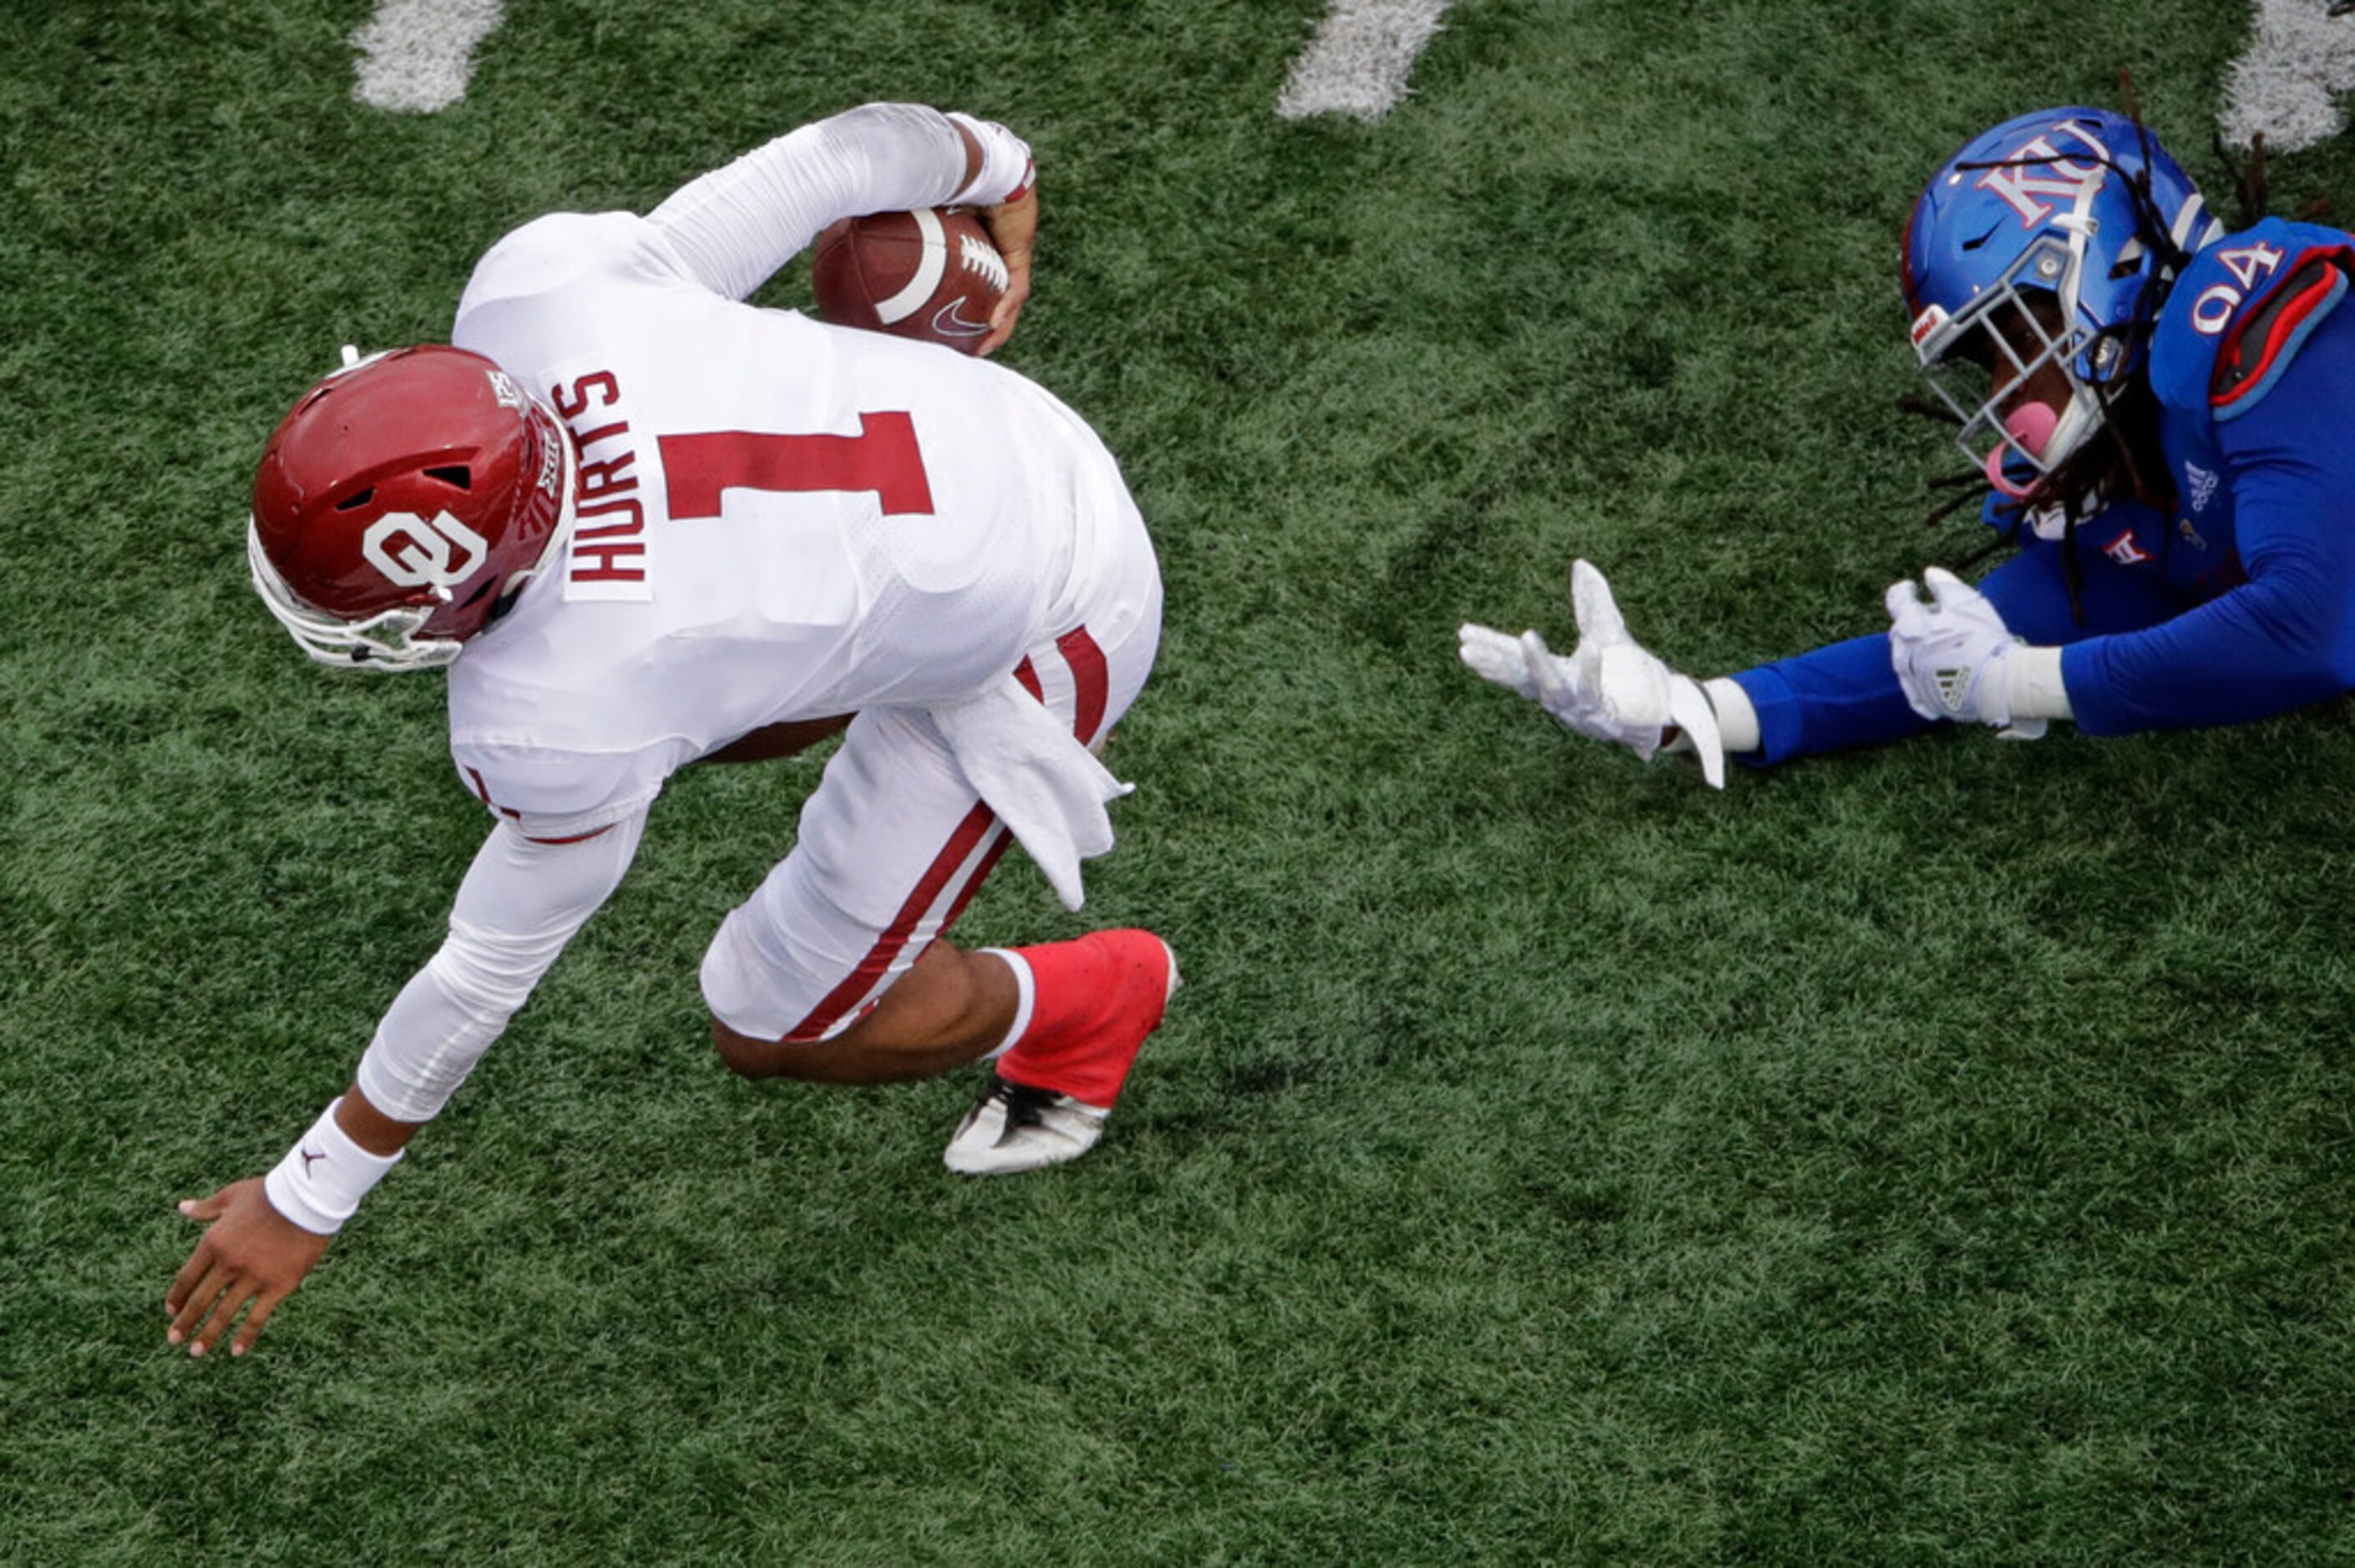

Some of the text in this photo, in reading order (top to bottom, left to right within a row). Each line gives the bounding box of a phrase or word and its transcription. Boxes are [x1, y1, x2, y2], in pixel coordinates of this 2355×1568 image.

[1974, 119, 2110, 230] KU
[2191, 240, 2285, 336] 94
[551, 370, 646, 583] HURTS
[657, 410, 934, 520] 1
[362, 508, 489, 587] OU
